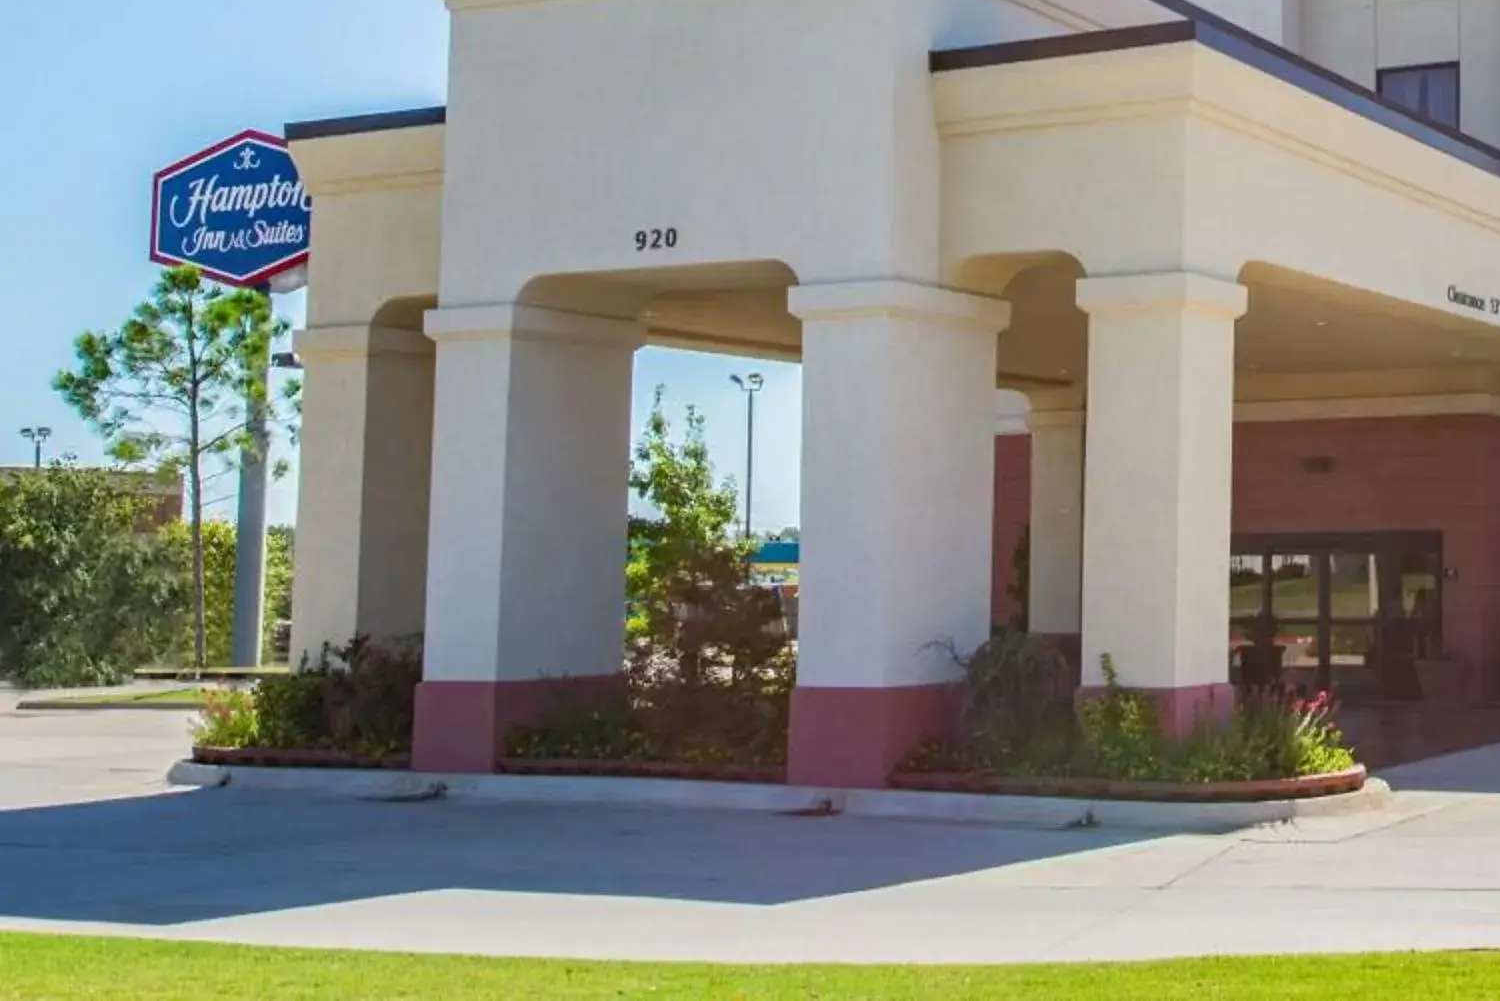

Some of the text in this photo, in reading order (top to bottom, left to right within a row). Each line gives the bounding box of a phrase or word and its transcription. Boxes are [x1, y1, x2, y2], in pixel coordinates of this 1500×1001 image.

[169, 174, 312, 228] Hampton
[181, 220, 304, 256] Inn & Suites
[635, 227, 677, 252] 920
